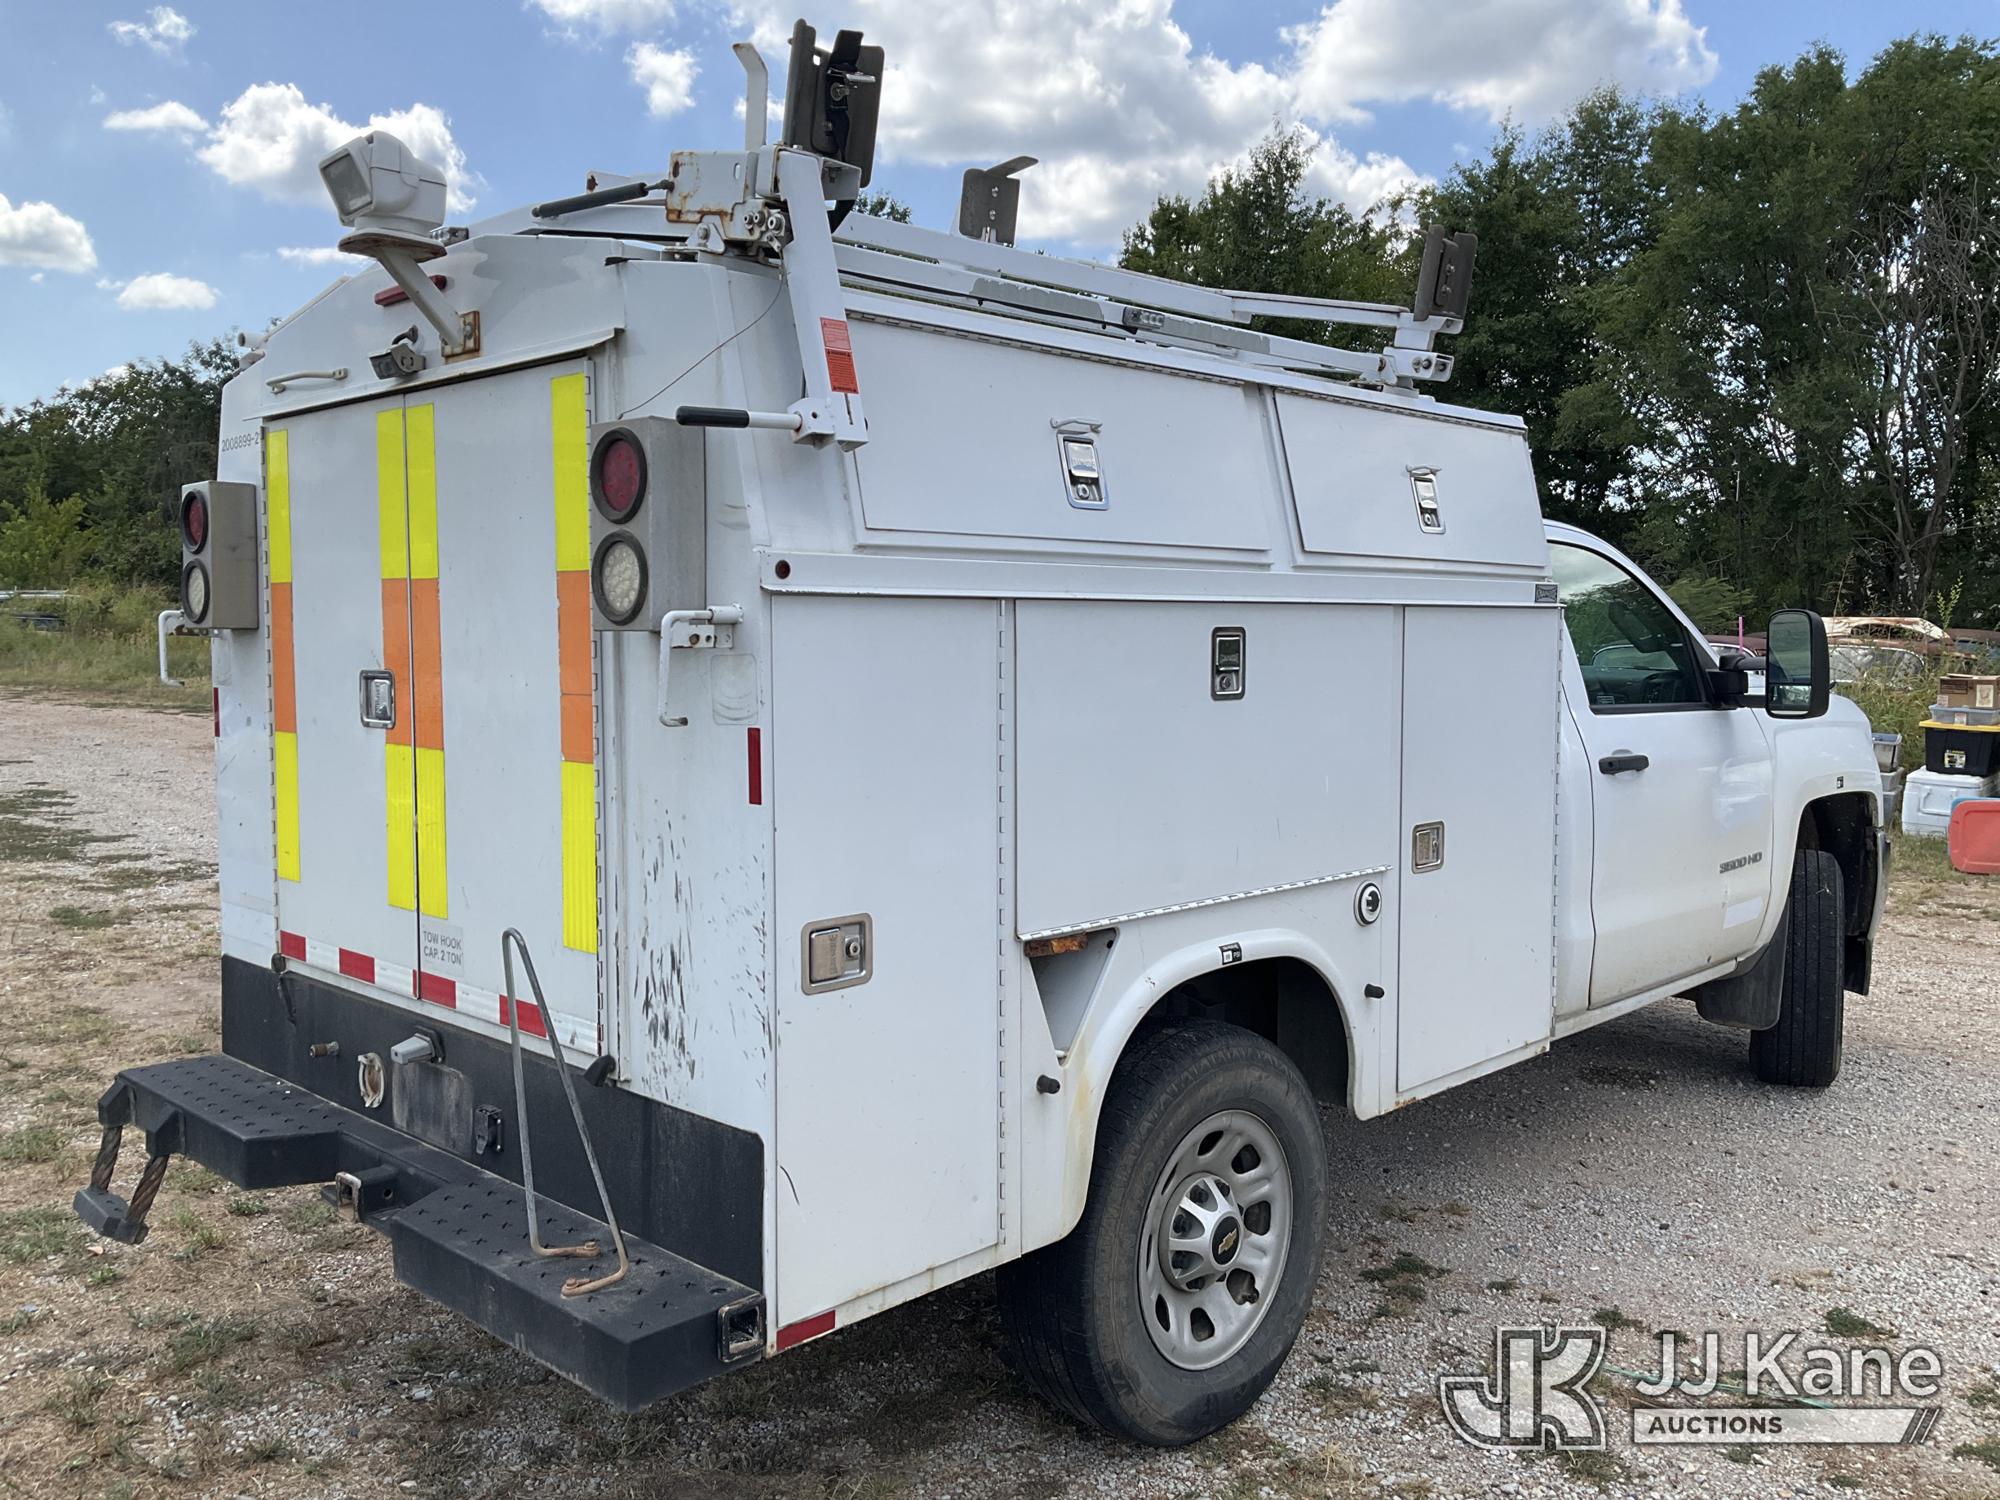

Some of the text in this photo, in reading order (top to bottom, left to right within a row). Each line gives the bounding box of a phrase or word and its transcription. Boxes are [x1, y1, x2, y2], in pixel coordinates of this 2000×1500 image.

[1747, 851, 1763, 865] HD
[423, 930, 462, 951] TOW HOOK
[423, 945, 463, 966] CAP. 2 TON
